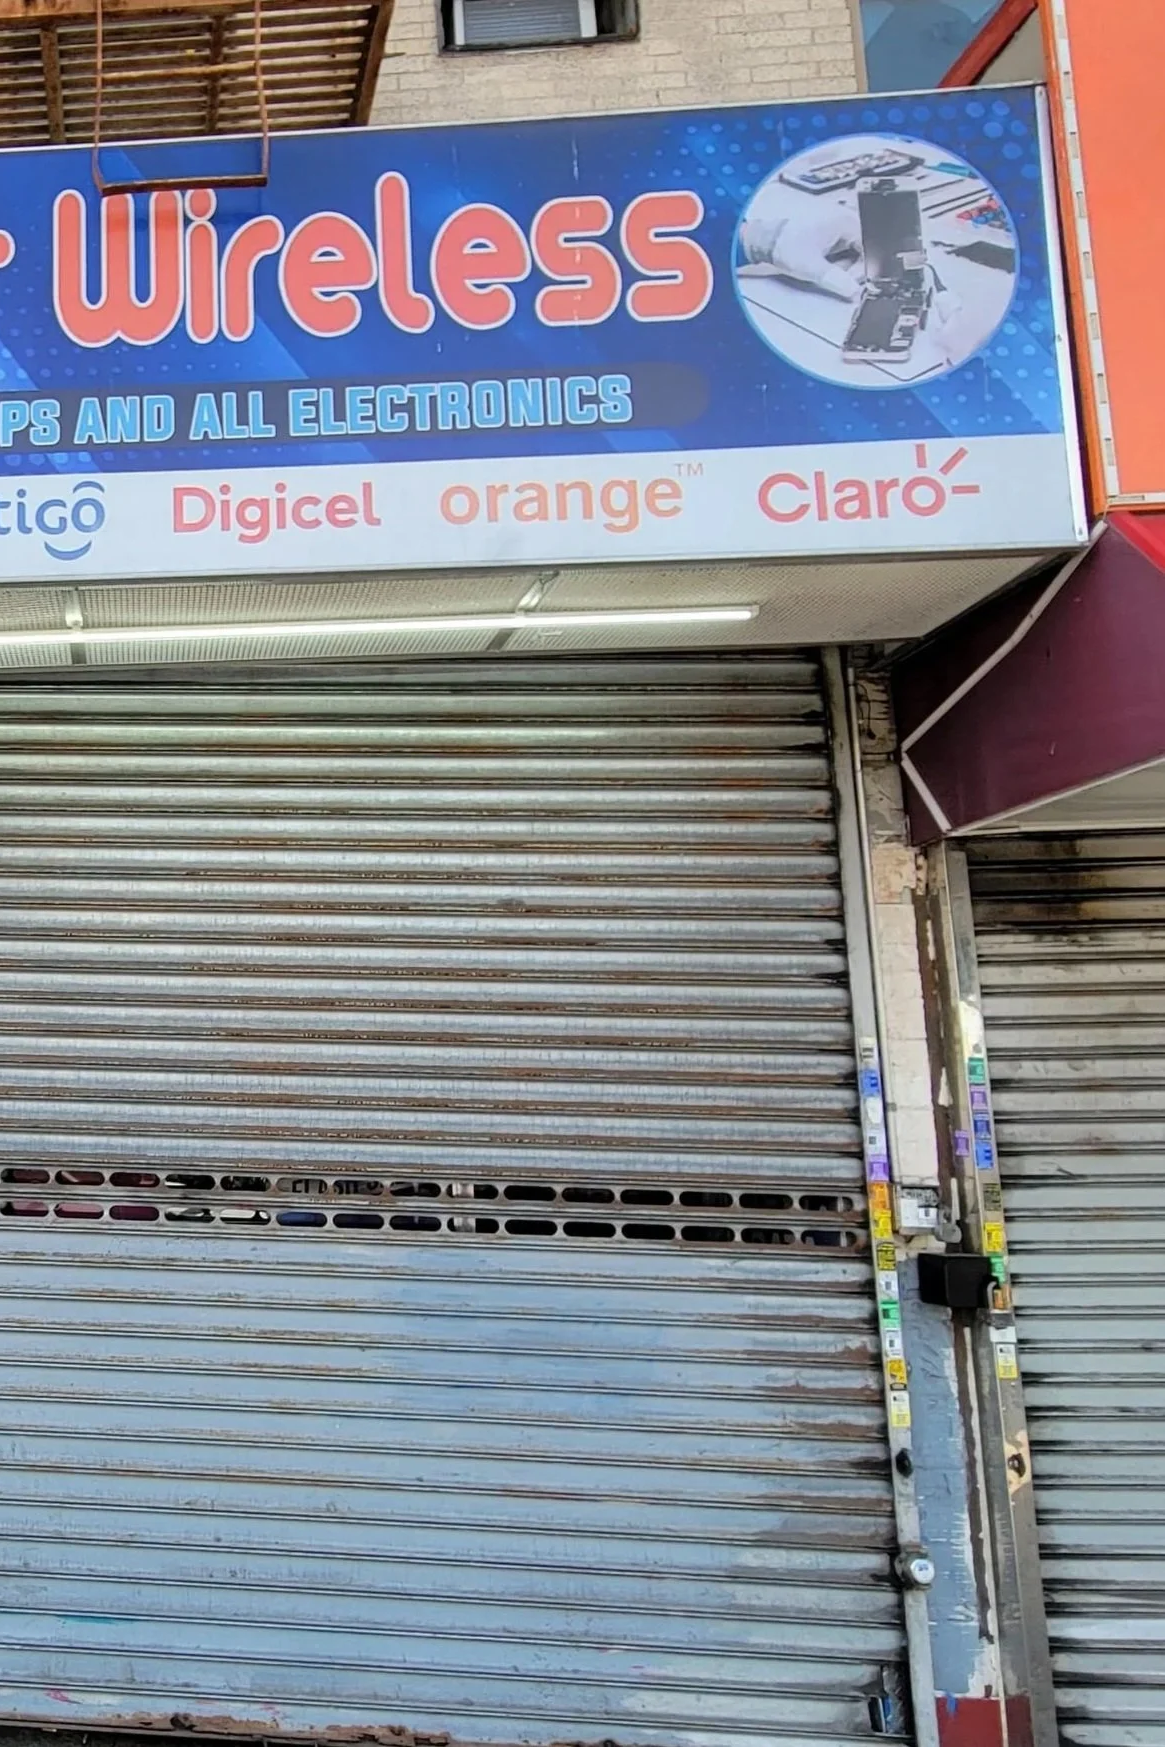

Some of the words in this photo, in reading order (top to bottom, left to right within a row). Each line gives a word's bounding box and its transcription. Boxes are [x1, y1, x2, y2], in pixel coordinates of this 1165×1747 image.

[53, 171, 714, 349] Wireless
[75, 393, 175, 445] AND
[190, 390, 275, 440] ALL
[288, 374, 633, 436] ELECTRONICS
[173, 482, 381, 543] Digicel
[440, 477, 683, 533] orange
[758, 469, 947, 523] Claro
